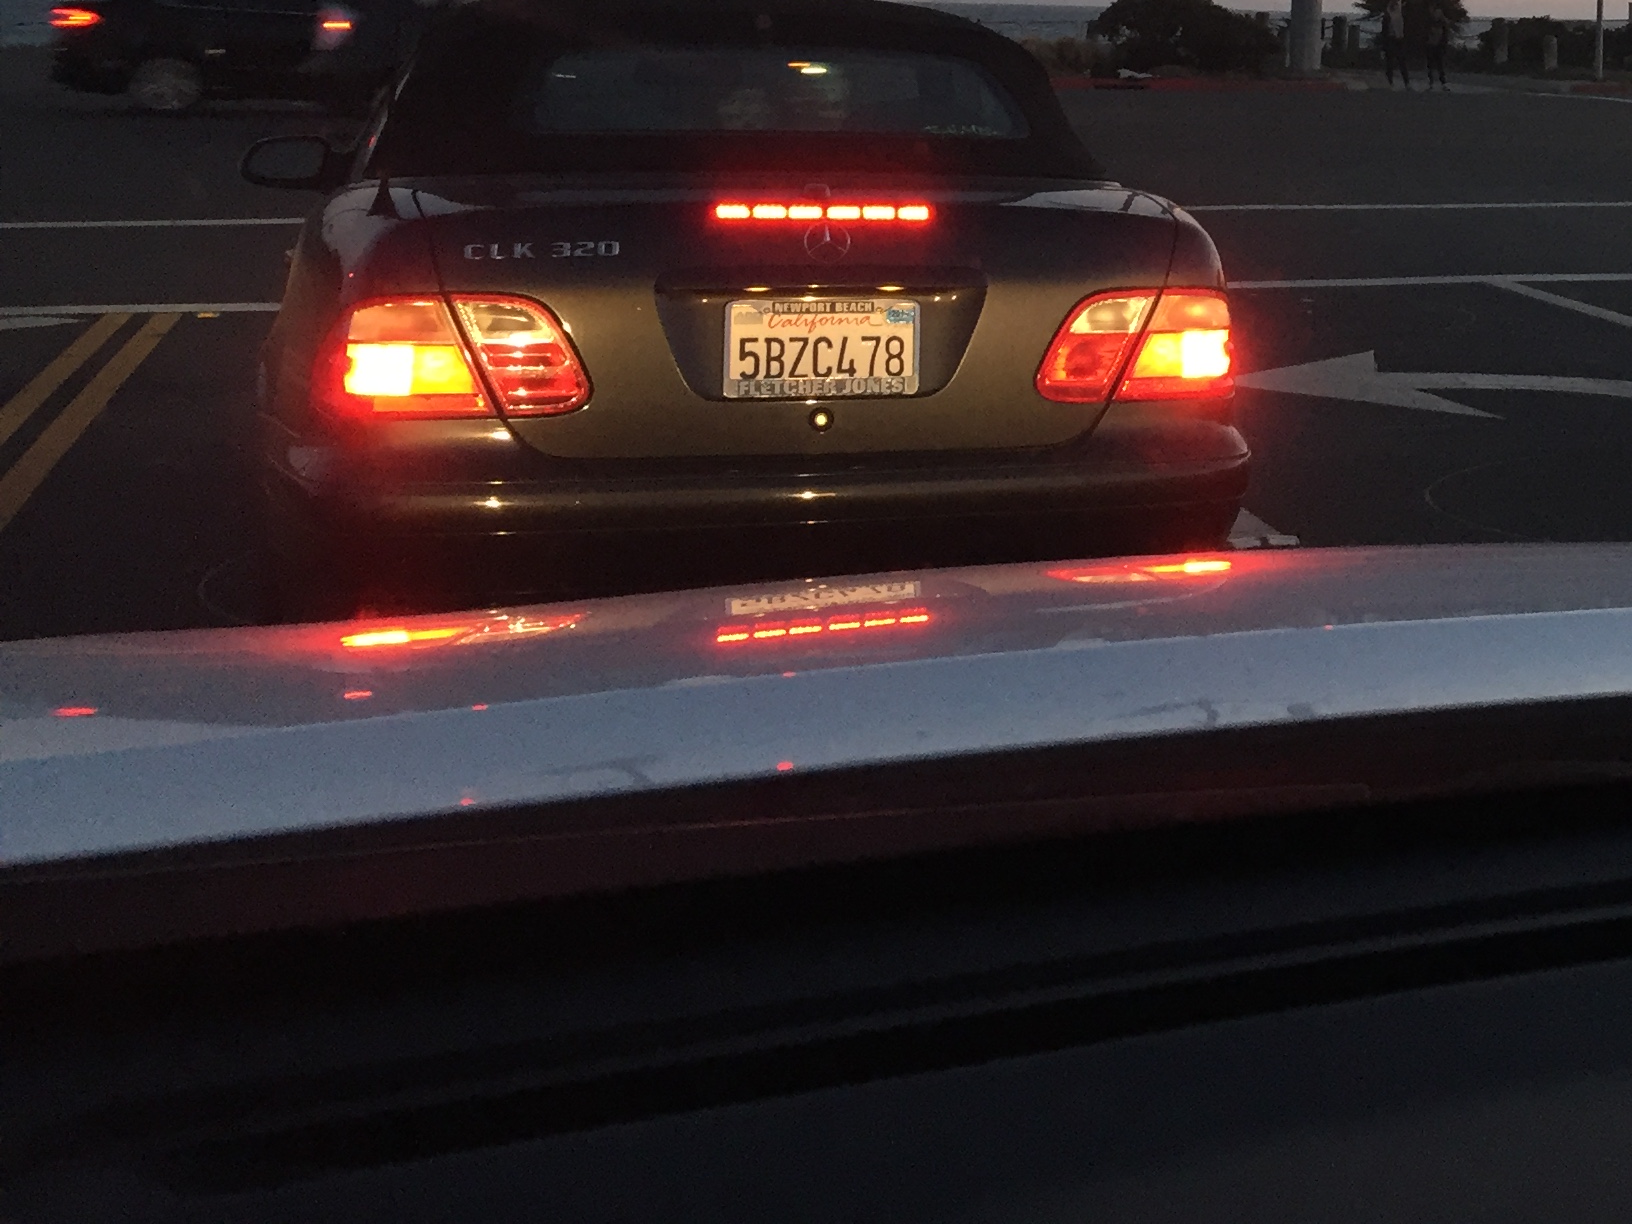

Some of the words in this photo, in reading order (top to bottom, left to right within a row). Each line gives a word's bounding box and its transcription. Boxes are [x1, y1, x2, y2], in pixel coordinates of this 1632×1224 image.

[463, 242, 536, 260] CLK
[551, 241, 620, 258] 320
[774, 302, 832, 313] NEWPORT
[835, 301, 873, 312] BEACH
[768, 314, 882, 333] California
[739, 335, 905, 379] 5BZC478
[738, 379, 837, 395] FLETCHER
[842, 377, 904, 394] JONES
